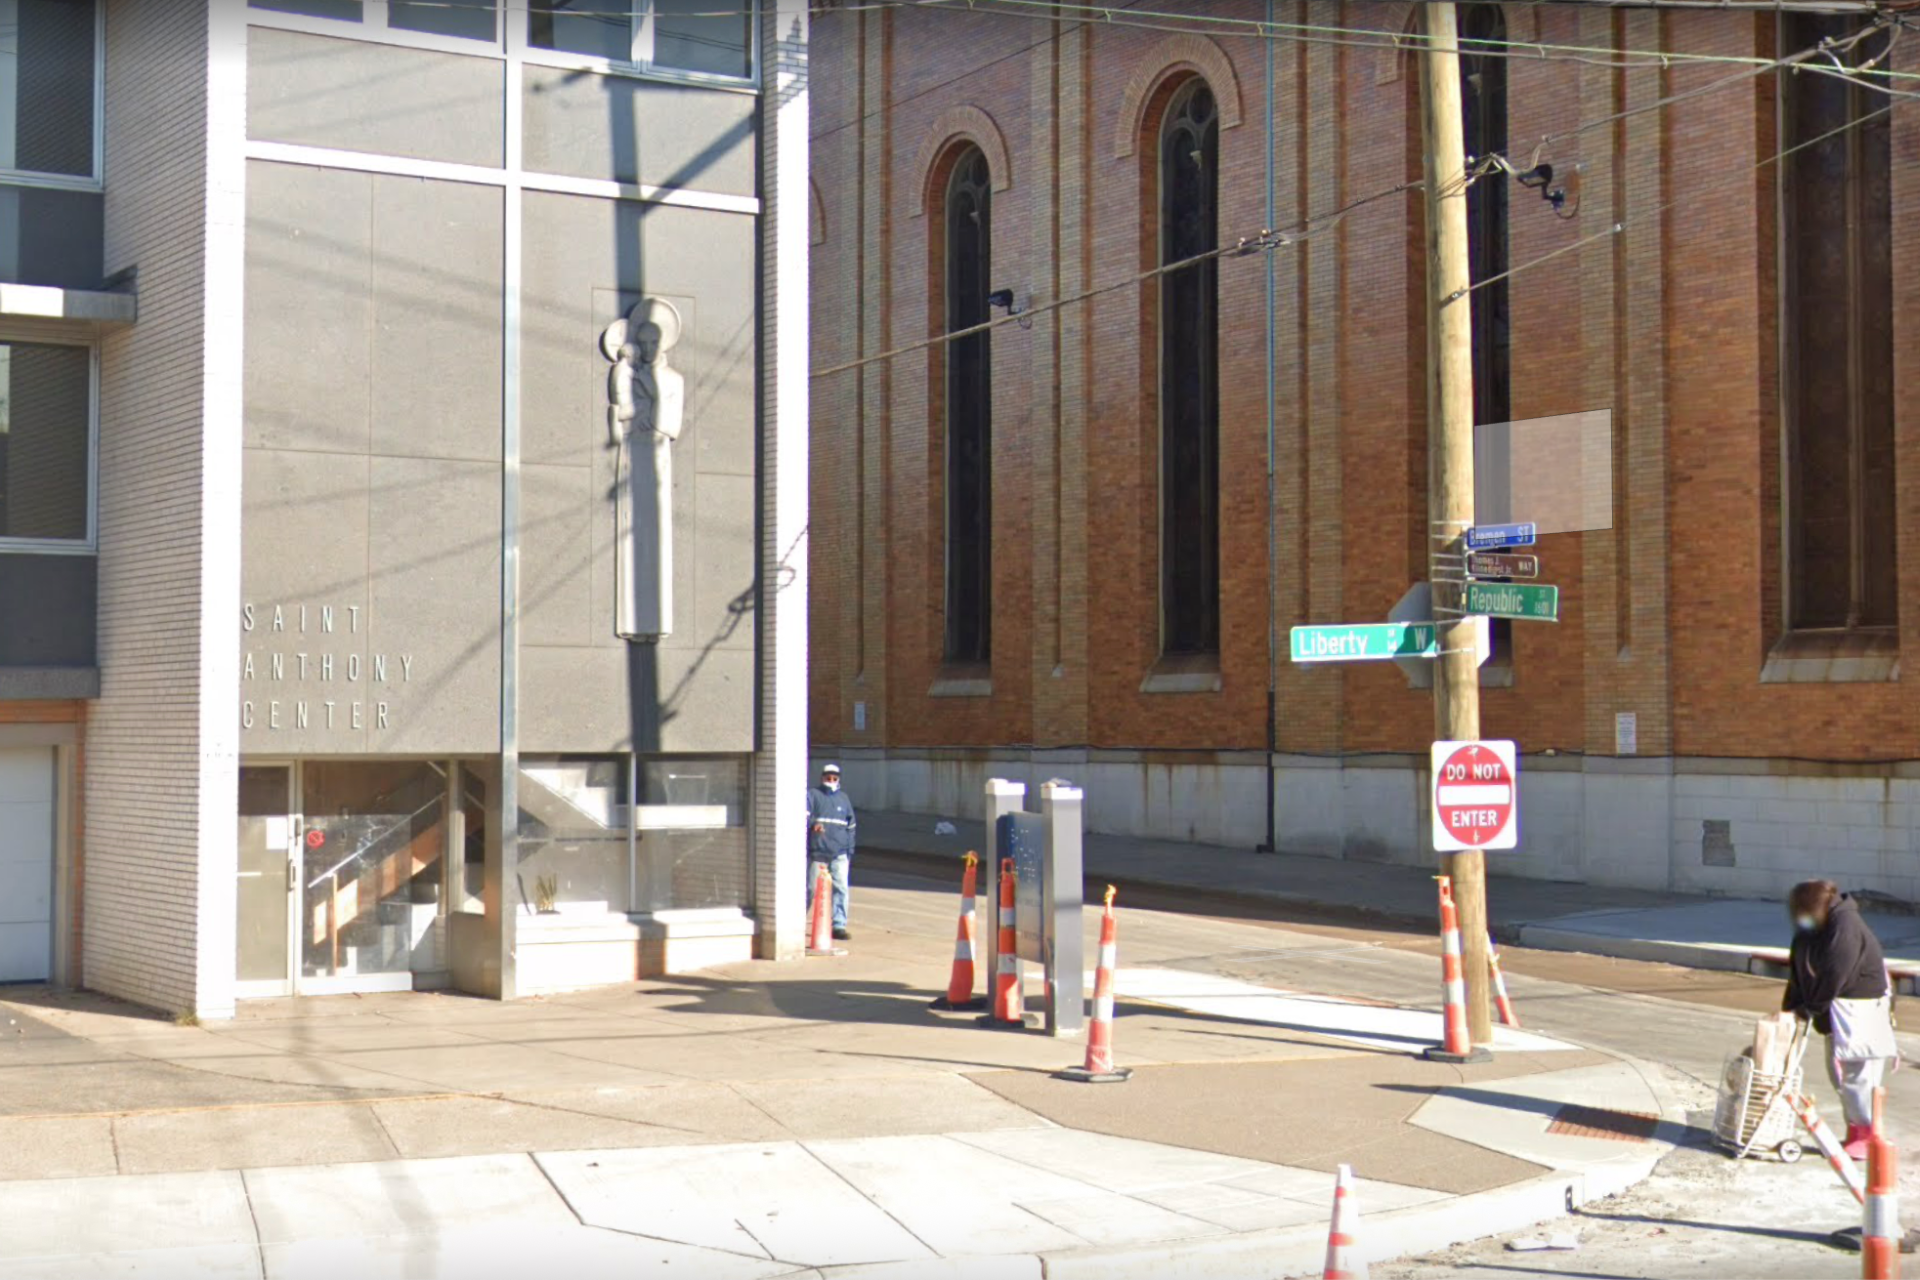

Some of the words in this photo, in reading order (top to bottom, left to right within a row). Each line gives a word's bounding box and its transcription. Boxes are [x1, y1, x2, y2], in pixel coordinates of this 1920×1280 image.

[1469, 530, 1505, 546] Bremen
[1517, 525, 1530, 542] ST
[1518, 561, 1532, 571] WAY
[1470, 587, 1524, 613] Republic
[243, 603, 360, 633] SAINT
[1299, 630, 1368, 656] Liberty
[1414, 627, 1427, 650] W
[243, 653, 413, 682] ANTHONY
[242, 700, 389, 730] CENTER
[1447, 764, 1466, 780] DO
[1473, 764, 1501, 779] NOT
[1452, 810, 1498, 827] ENTER
